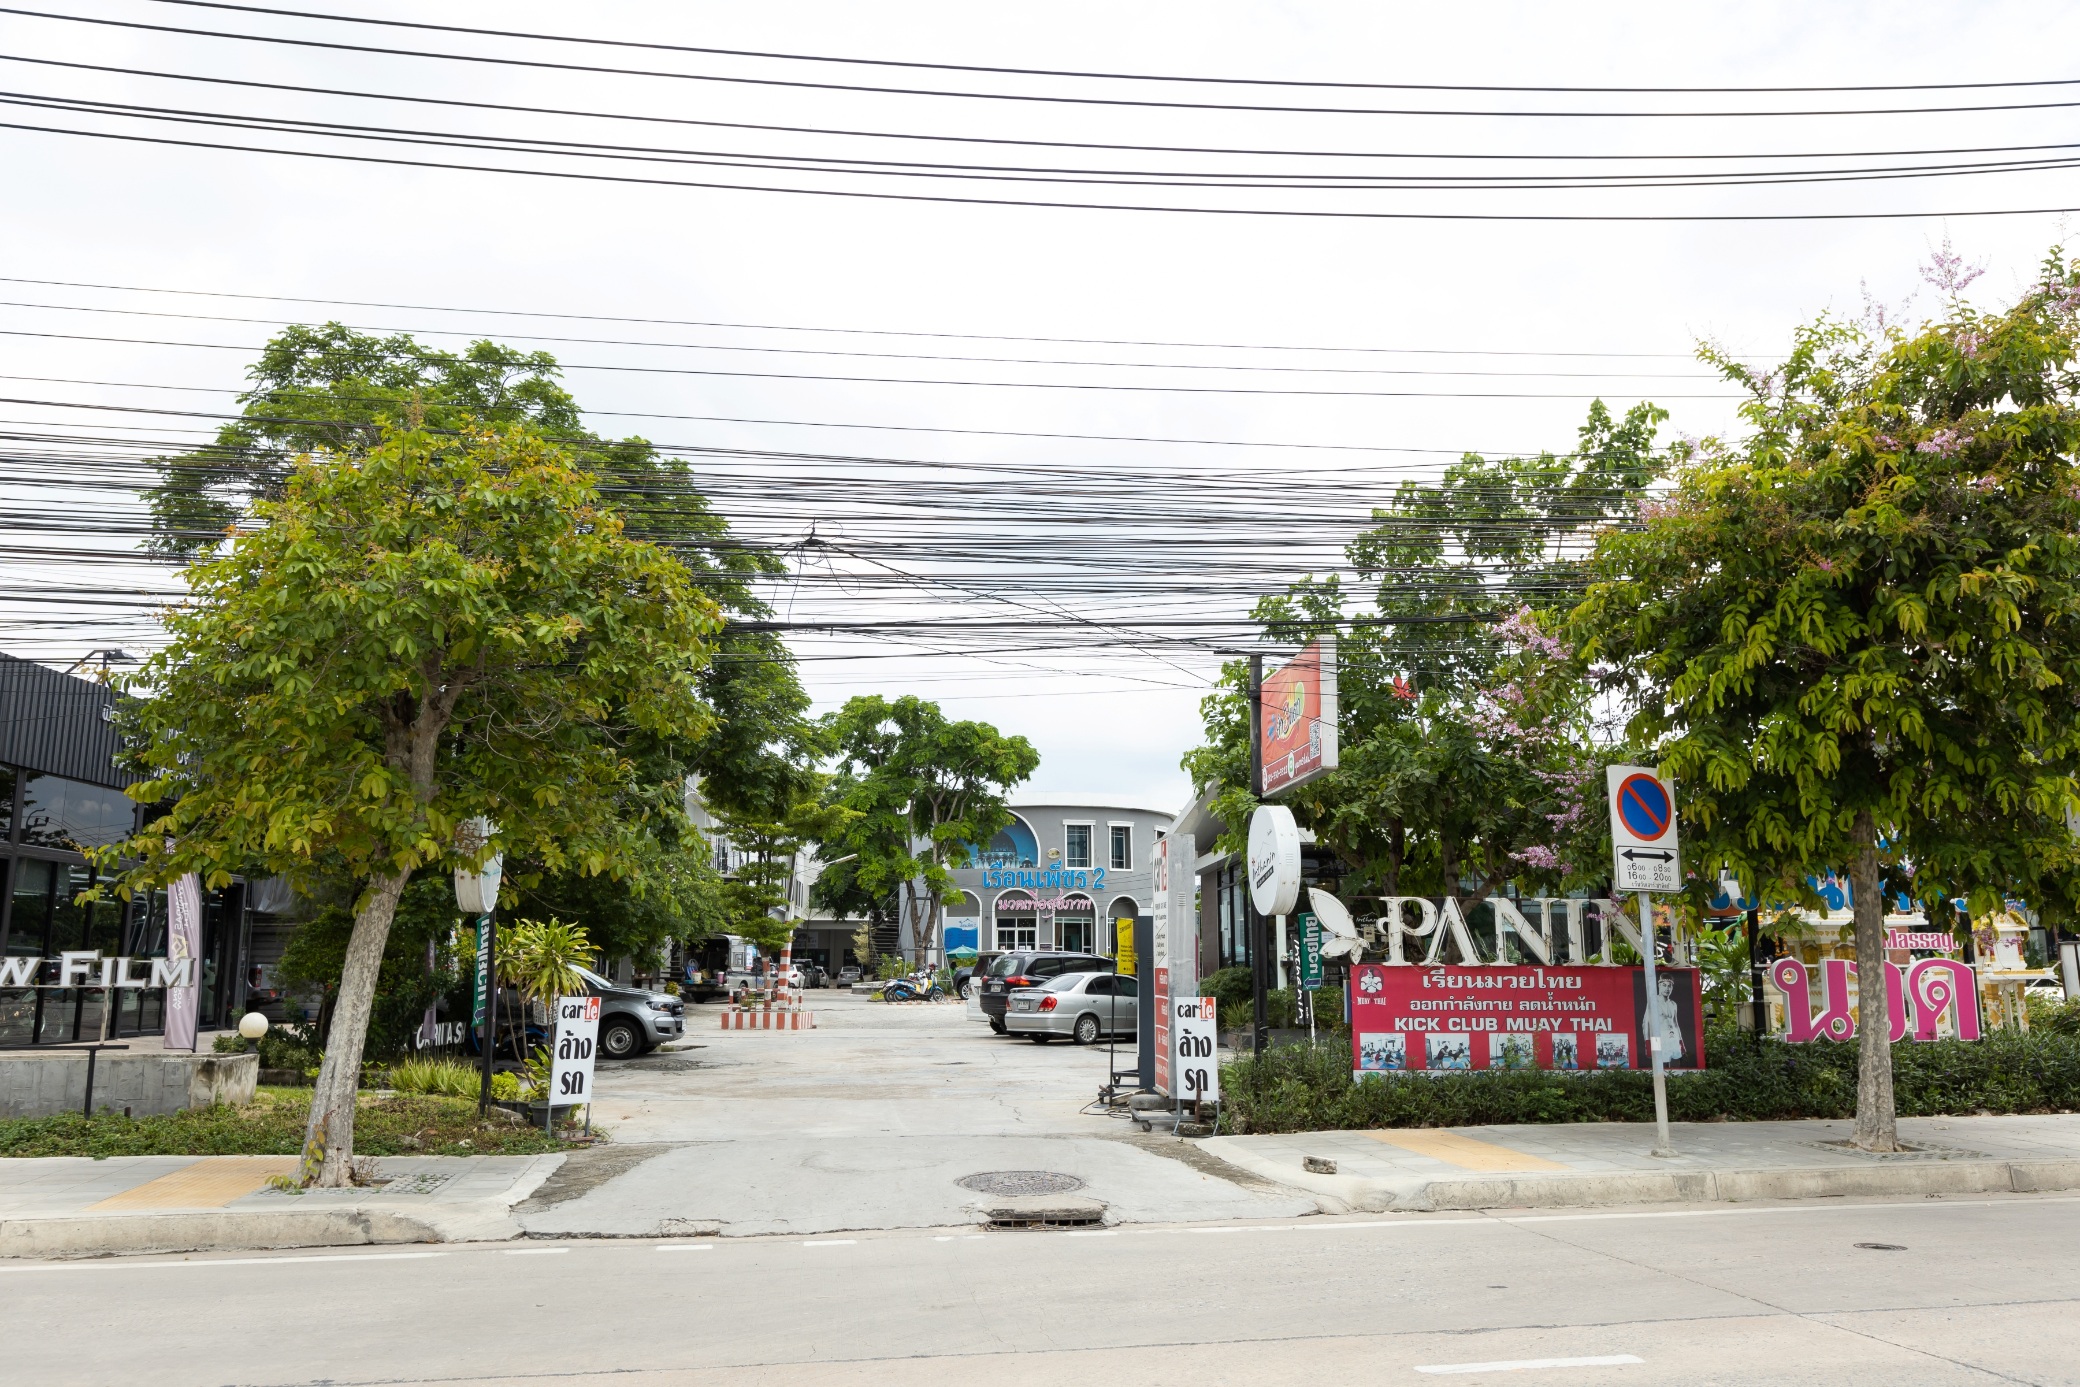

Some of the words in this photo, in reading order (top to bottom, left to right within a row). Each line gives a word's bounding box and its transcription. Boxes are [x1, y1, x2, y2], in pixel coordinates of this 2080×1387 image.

[1092, 867, 1106, 890] 2
[1375, 895, 1698, 968] PANIN
[1303, 916, 1319, 974] มวยไทย
[60, 950, 195, 988] FILM
[1422, 968, 1582, 989] เรียนมวยไทย
[1410, 995, 1512, 1011] ออกกำลังกาย
[1519, 991, 1596, 1011] ลดน้ำหนัก
[1394, 1017, 1440, 1031] KICK
[1448, 1017, 1498, 1031] CLUB
[1506, 1017, 1562, 1031] MUAY
[1572, 1017, 1612, 1031] THAI
[559, 1030, 592, 1060] ล้าง
[1179, 1028, 1212, 1058] ล้าง
[560, 1071, 585, 1096] รถ
[1185, 1068, 1208, 1091] รถ
